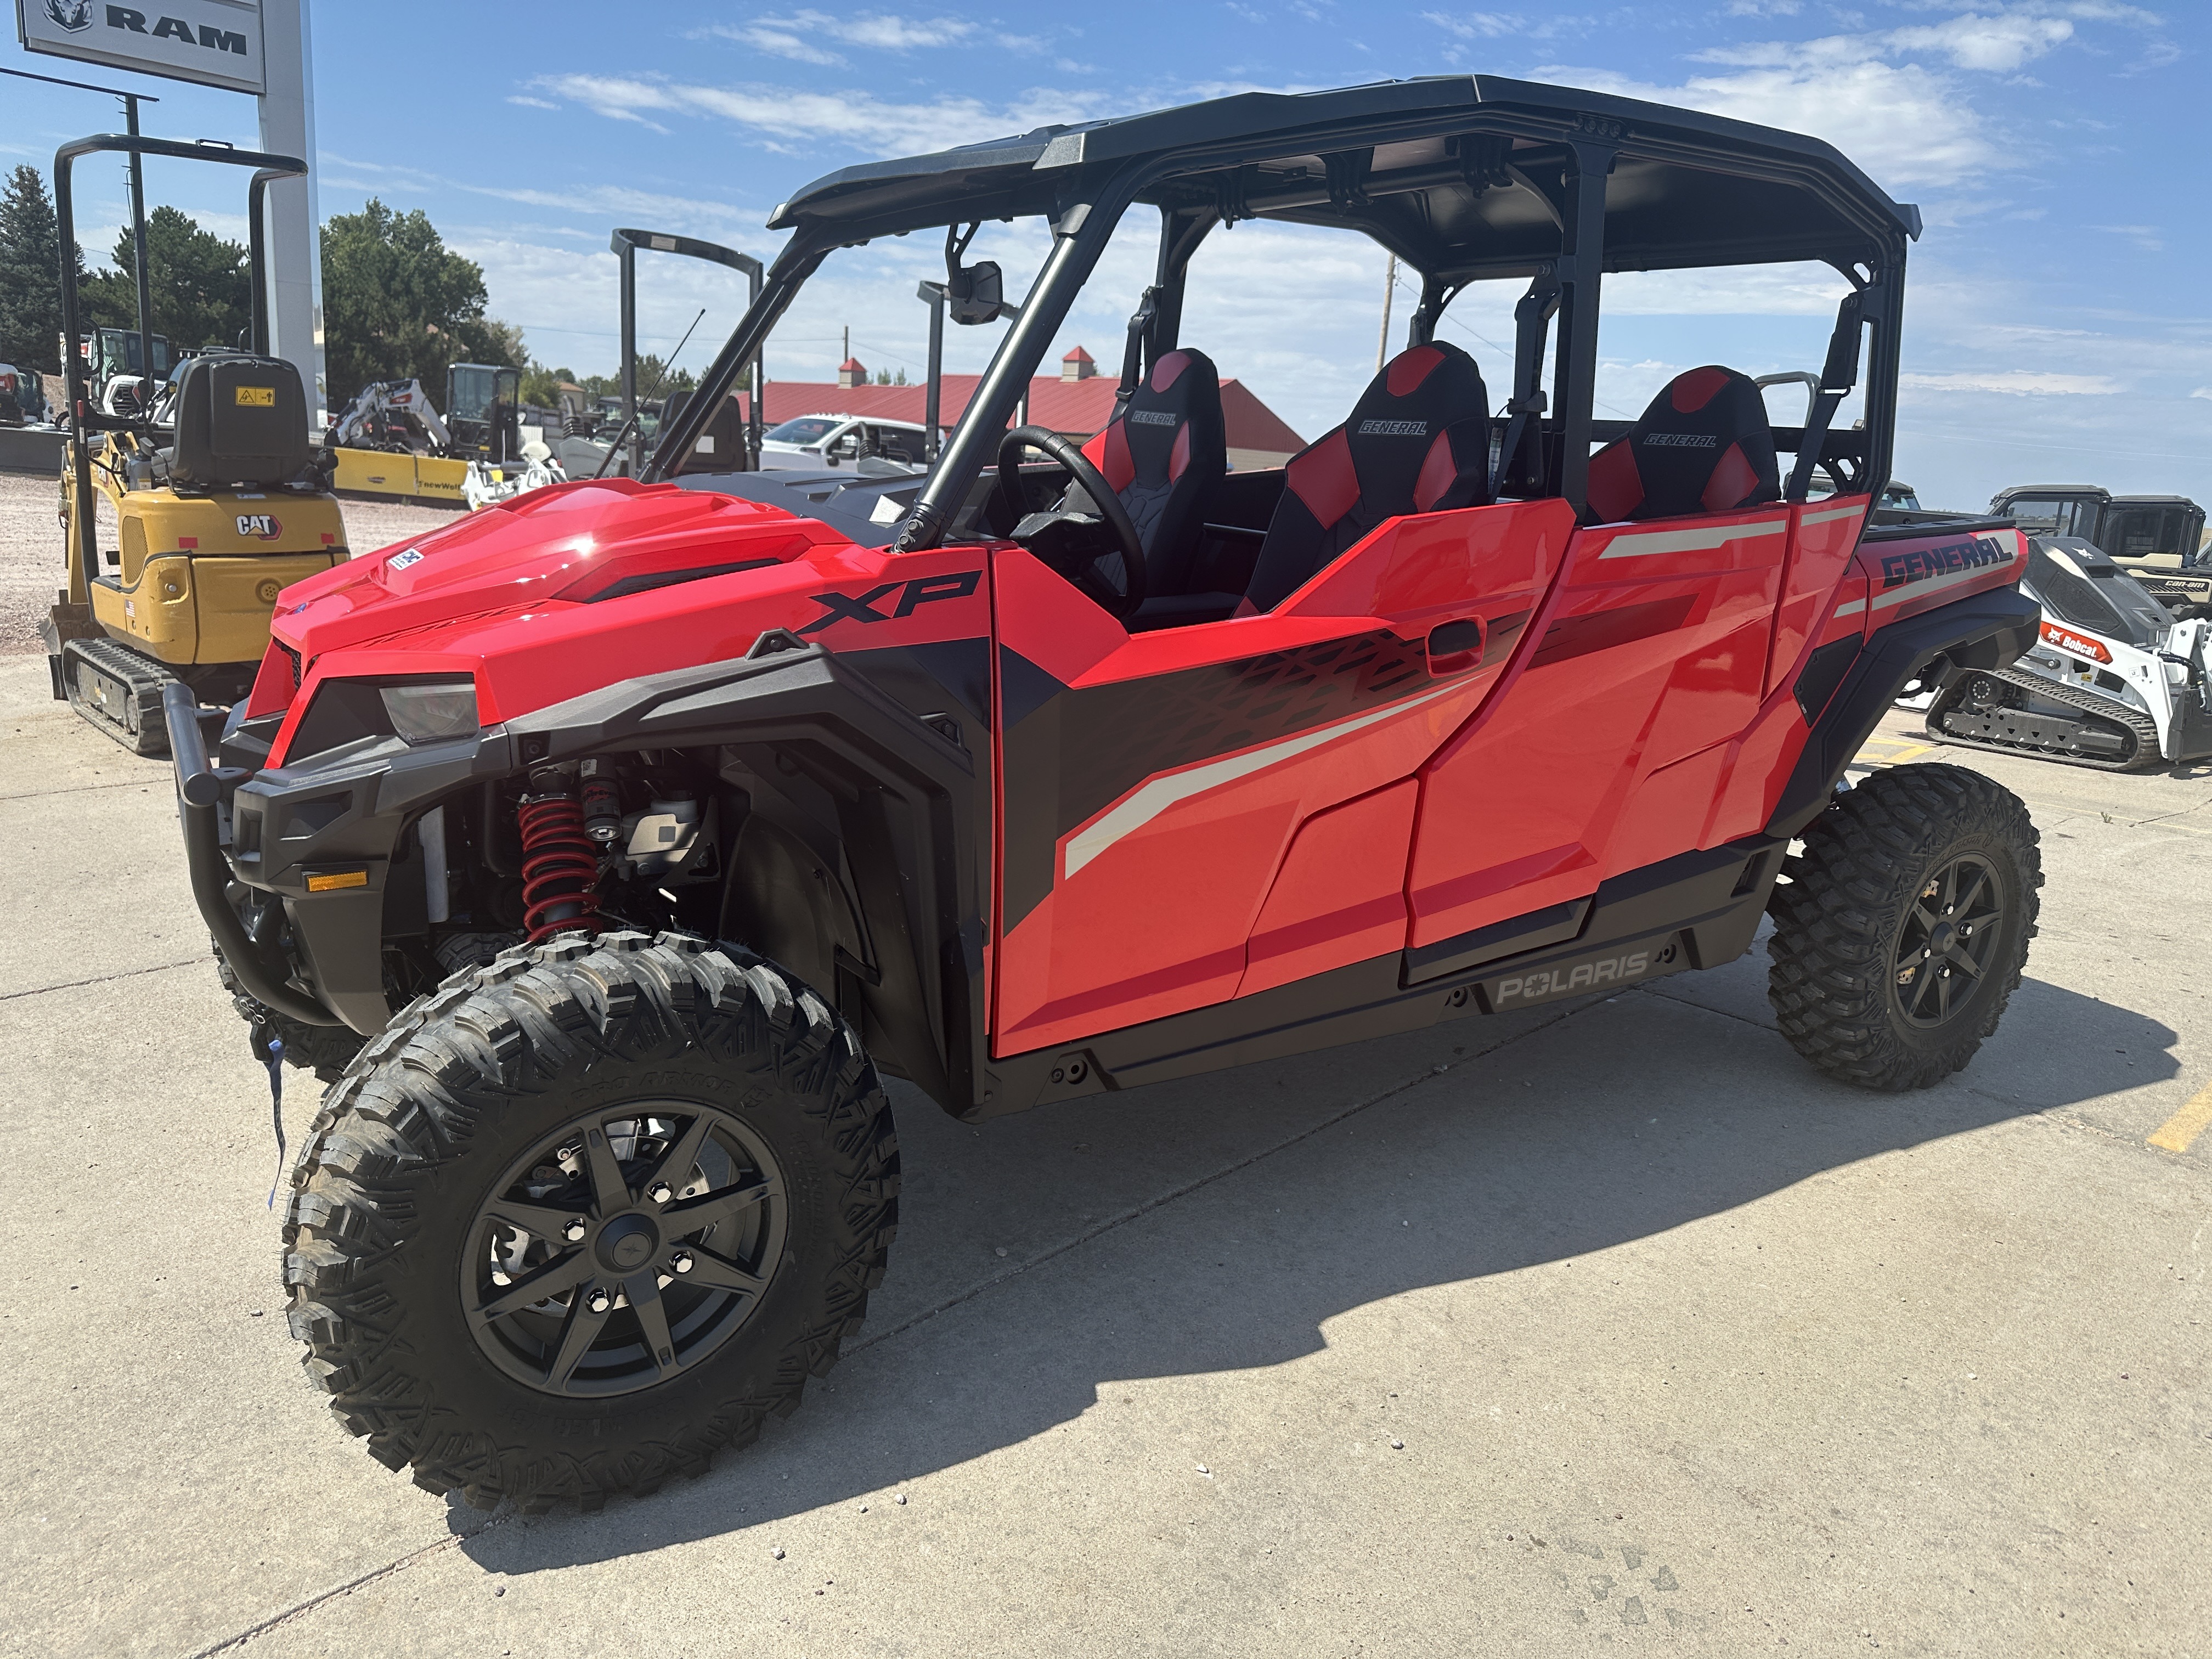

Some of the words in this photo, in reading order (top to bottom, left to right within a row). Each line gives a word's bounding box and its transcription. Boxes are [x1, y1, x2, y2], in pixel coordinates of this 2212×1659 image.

[106, 4, 247, 56] RAM
[1132, 410, 1176, 426] GENERAL
[1358, 420, 1427, 435] GENERAL
[1644, 433, 1716, 447] GENERAL
[236, 515, 270, 535] CAT
[1881, 537, 2013, 588] GENERAL
[793, 569, 984, 636] XP
[2062, 635, 2097, 657] Bobcat
[1497, 952, 1649, 1004] POLARIS
[571, 1076, 630, 1103] PRO
[639, 1071, 738, 1096] ARMOR
